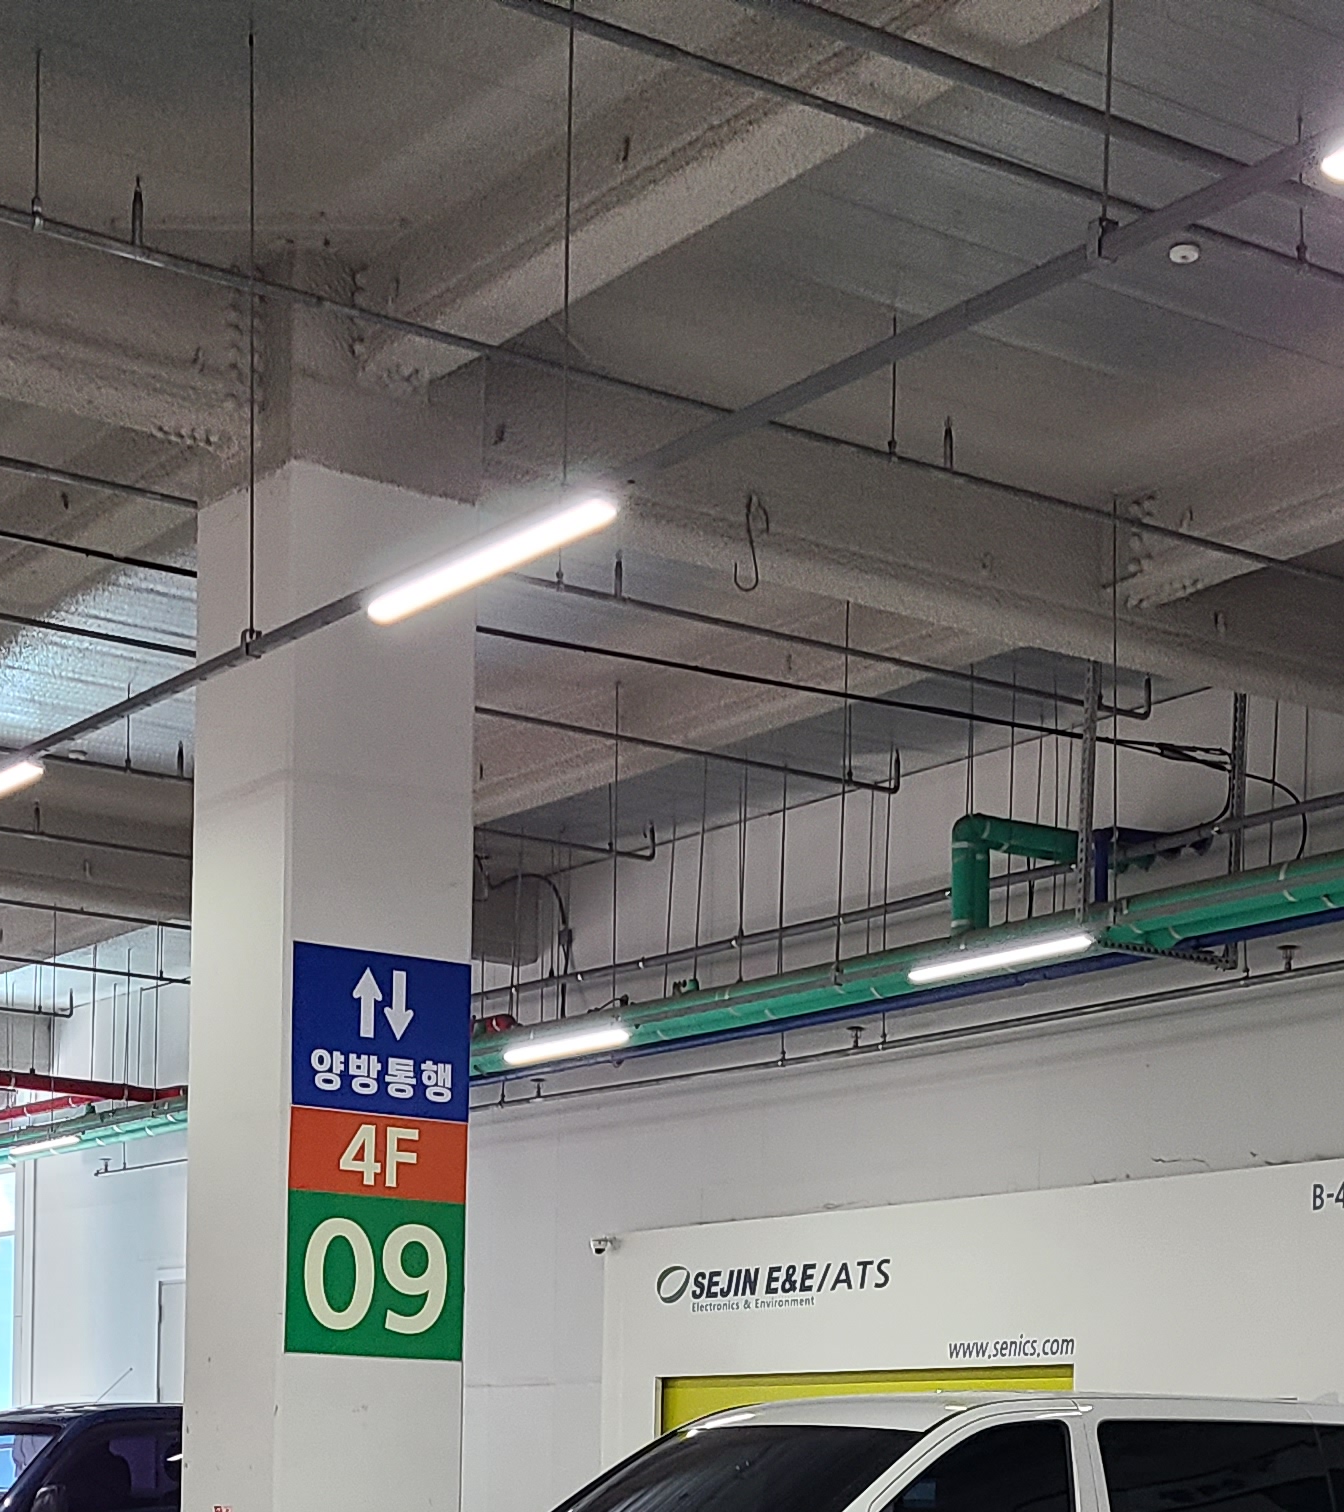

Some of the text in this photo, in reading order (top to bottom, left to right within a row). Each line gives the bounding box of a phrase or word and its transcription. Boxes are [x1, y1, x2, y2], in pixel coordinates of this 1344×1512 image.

[311, 1049, 452, 1103] 양방통행
[339, 1124, 419, 1188] 4F
[304, 1217, 447, 1334] 09
[692, 1268, 759, 1299] SEJIN
[692, 1296, 814, 1313] Electronics & Environment
[949, 1334, 1074, 1359] www.senics.com
